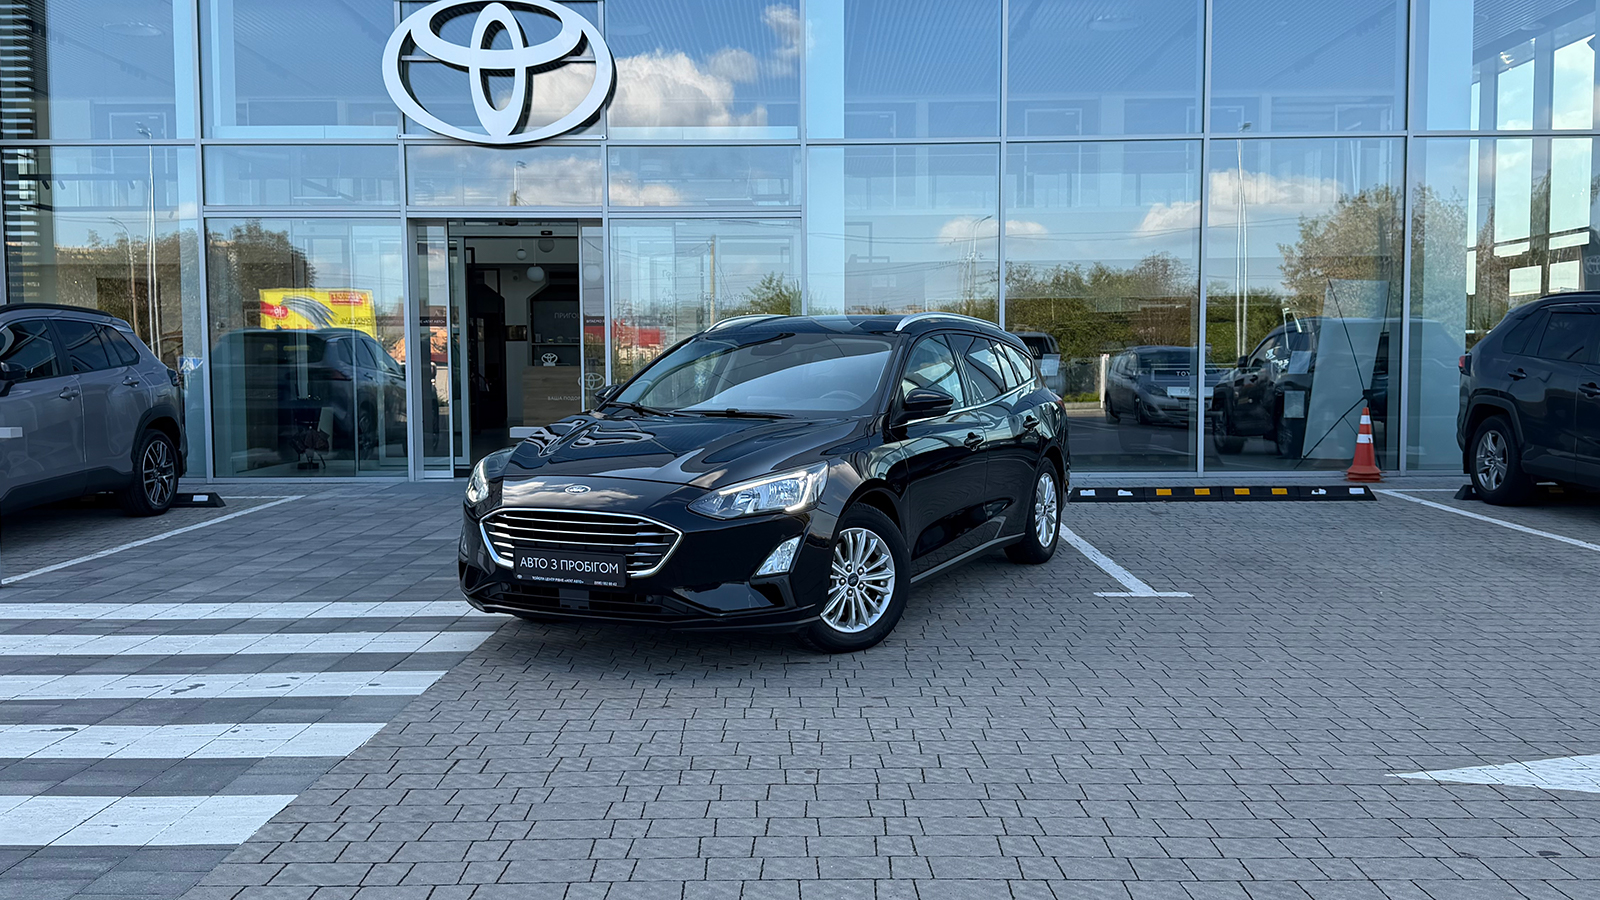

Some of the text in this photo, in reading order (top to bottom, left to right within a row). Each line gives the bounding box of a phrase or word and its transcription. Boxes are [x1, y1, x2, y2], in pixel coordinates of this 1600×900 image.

[520, 557, 619, 574] АВТО З ПРОБІГОМ
